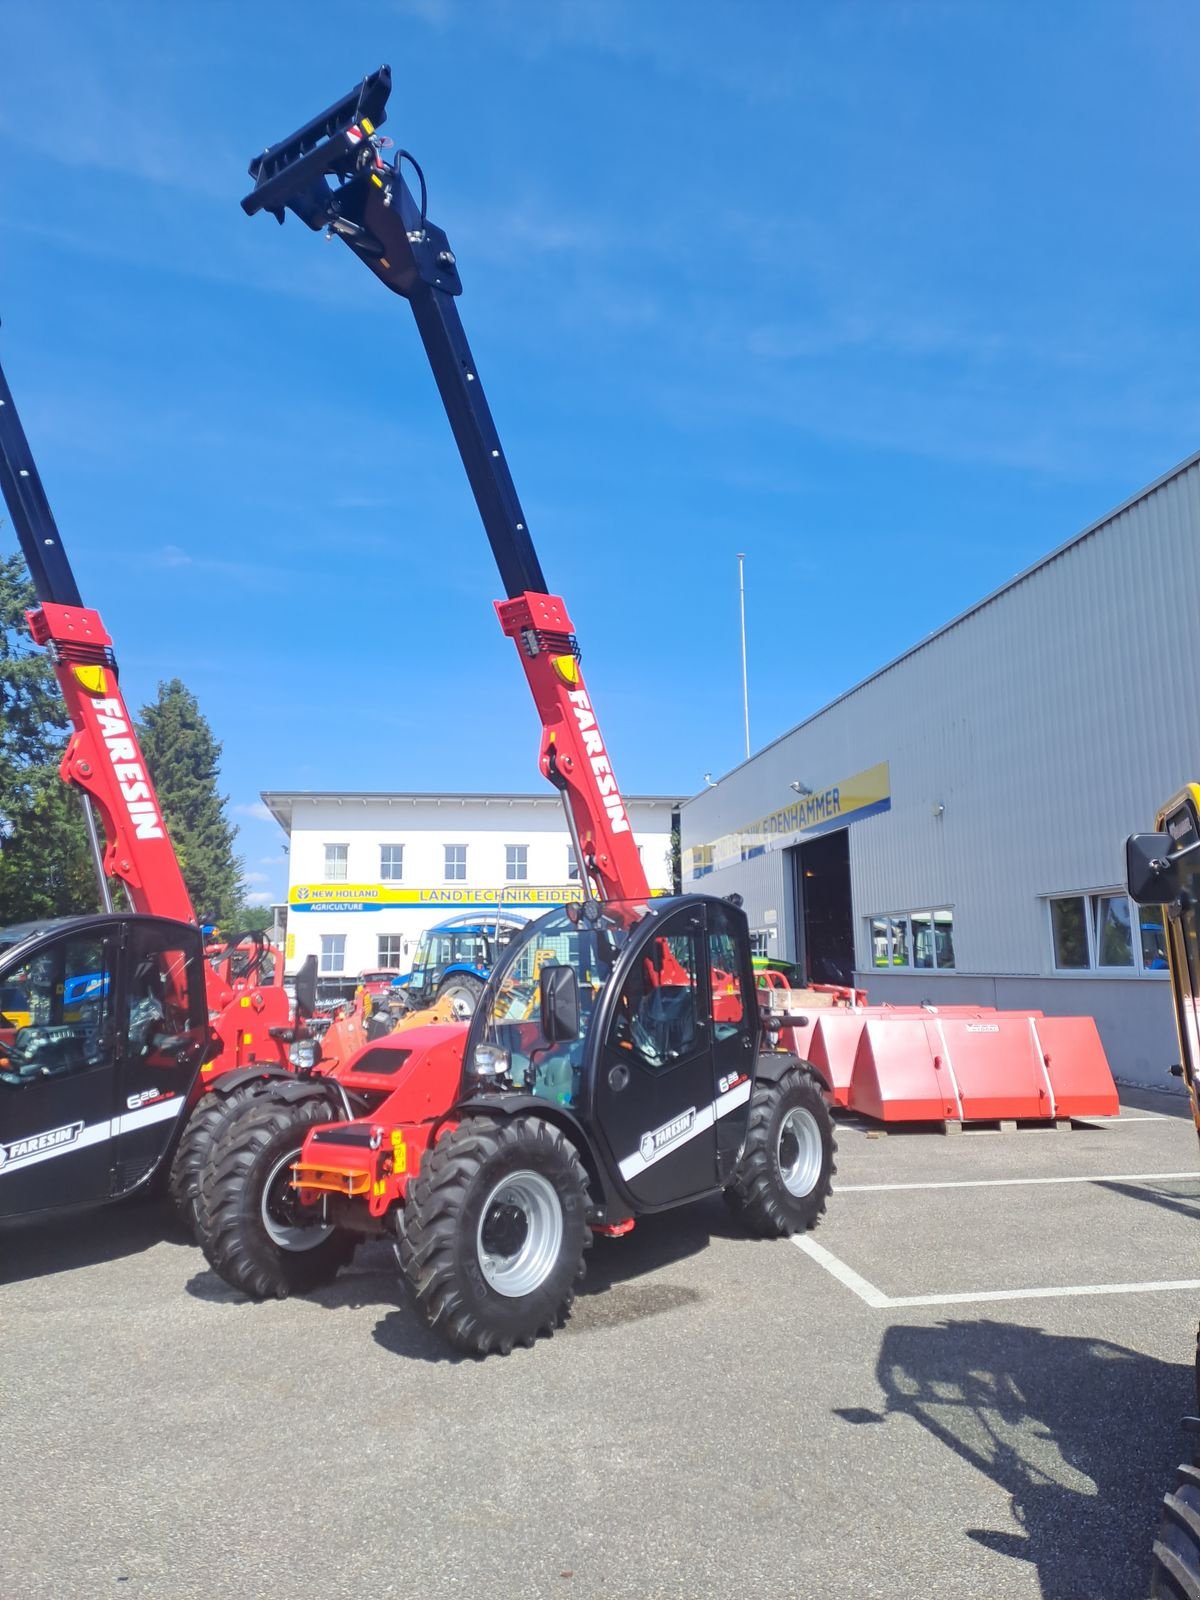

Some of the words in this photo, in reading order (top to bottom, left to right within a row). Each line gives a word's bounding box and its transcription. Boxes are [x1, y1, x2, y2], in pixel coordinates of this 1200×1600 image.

[91, 698, 165, 840] FARESIN
[567, 689, 631, 834] FARESIN
[762, 787, 841, 833] EDENHAMMER
[310, 903, 364, 911] AGRICULTURE
[311, 889, 334, 898] NEW
[335, 889, 379, 898] HOLLAND
[419, 889, 533, 902] LANDTECHNIK
[10, 1127, 73, 1159] FARESIN
[655, 1115, 691, 1147] FARESIN
